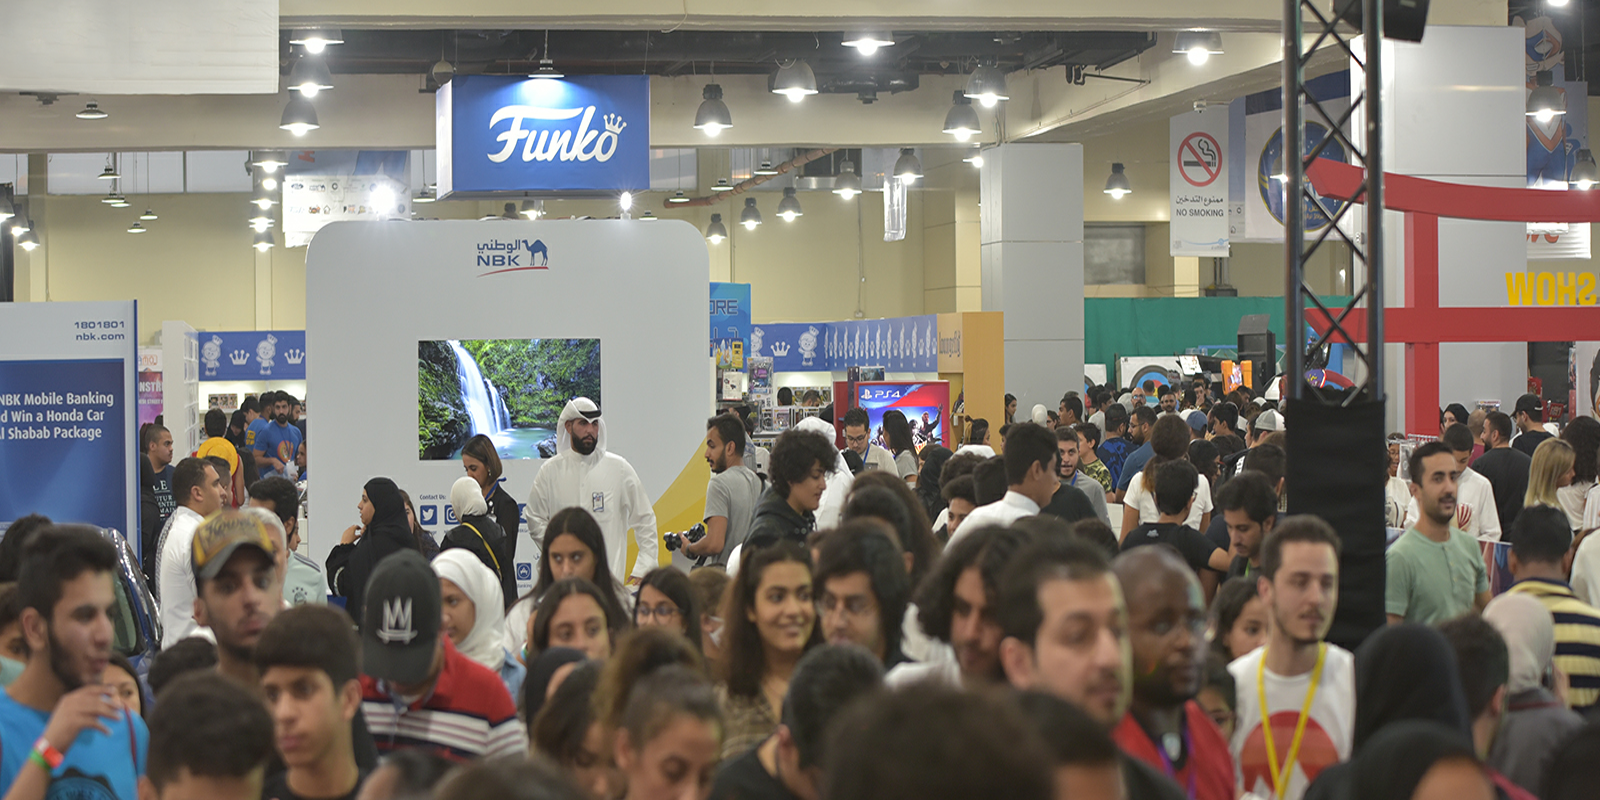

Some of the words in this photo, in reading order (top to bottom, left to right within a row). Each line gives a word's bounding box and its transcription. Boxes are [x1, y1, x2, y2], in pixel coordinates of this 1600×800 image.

[487, 105, 618, 163] Funko
[1176, 195, 1202, 205] التدخين
[1203, 196, 1223, 206] ممنوع
[1176, 208, 1187, 216] NO
[1189, 208, 1224, 216] SMOKING
[477, 239, 520, 254] الوطني
[477, 255, 520, 266] NBK
[74, 321, 125, 329] 1801801
[76, 333, 125, 341] nbk.com
[24, 392, 63, 406] Mobile
[66, 391, 114, 407] Banking
[875, 390, 901, 398] PS4
[11, 410, 33, 422] Win
[36, 412, 43, 422] a
[46, 408, 83, 421] Honda
[86, 409, 105, 421] Car
[8, 426, 51, 440] Shabab
[53, 425, 102, 441] Package
